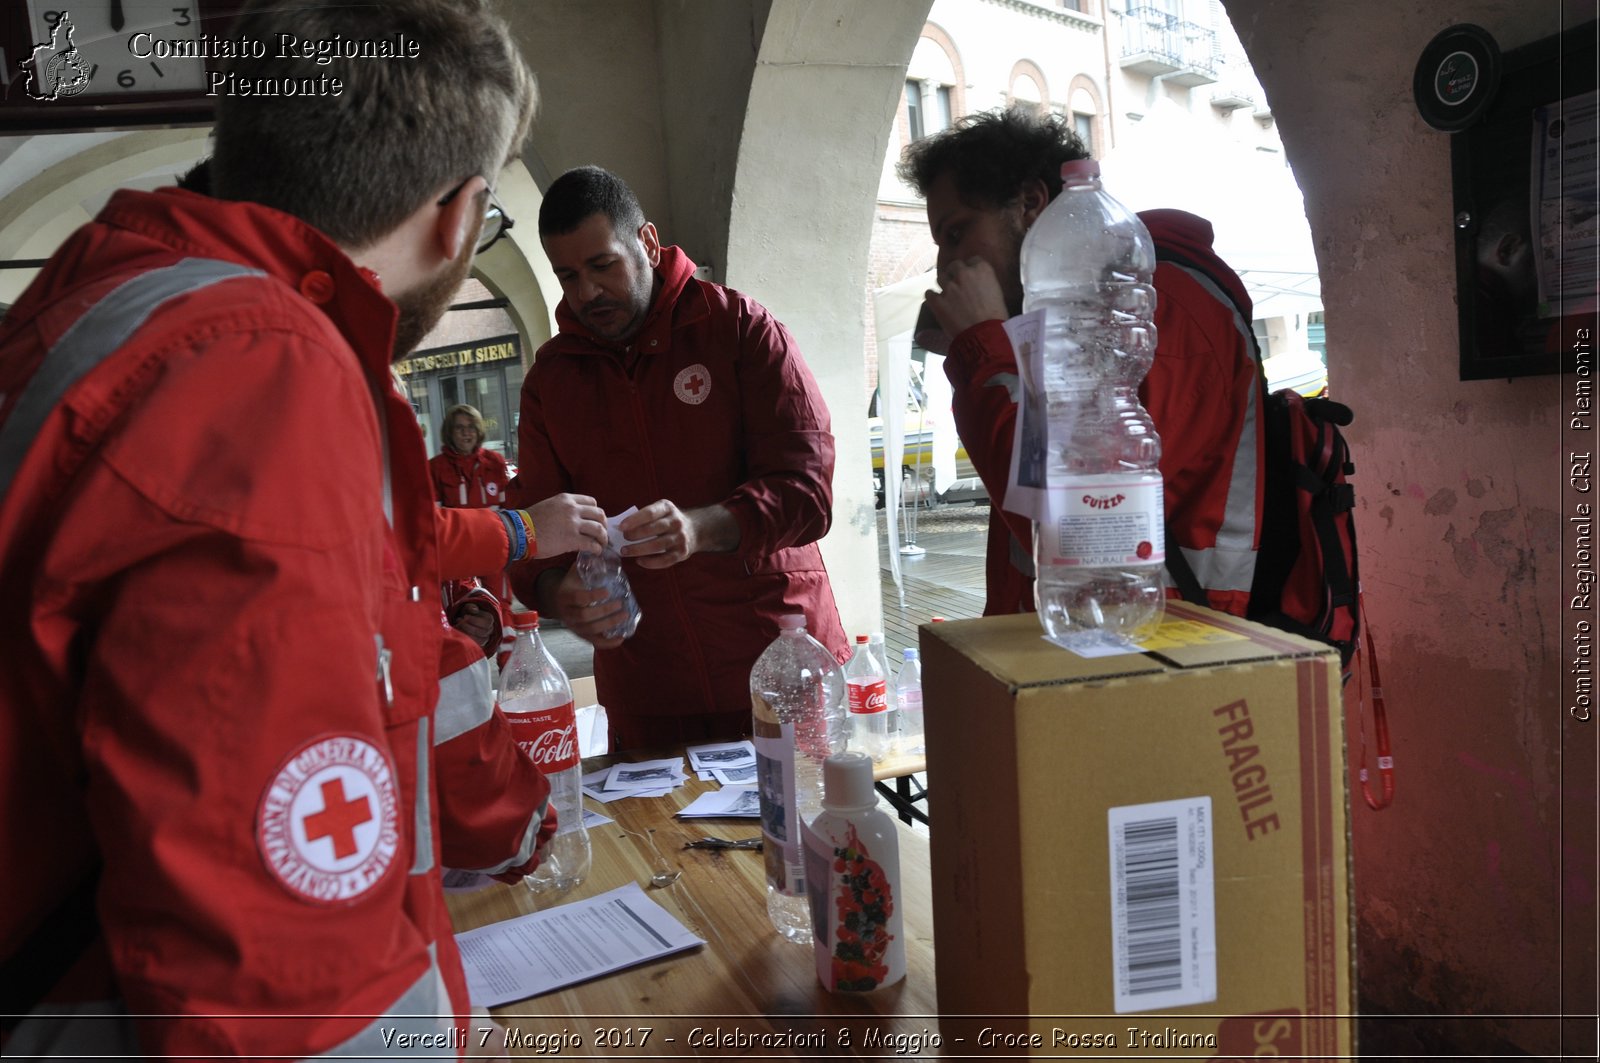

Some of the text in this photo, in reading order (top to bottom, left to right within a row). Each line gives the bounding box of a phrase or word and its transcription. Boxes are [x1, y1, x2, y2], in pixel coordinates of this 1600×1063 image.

[172, 8, 191, 26] 3
[117, 70, 136, 88] 6
[458, 349, 474, 365] DI
[475, 342, 518, 363] SIENA
[1082, 494, 1126, 509] GUIZZA
[1082, 557, 1124, 565] NATURALE
[1213, 698, 1281, 841] FRAGILE
